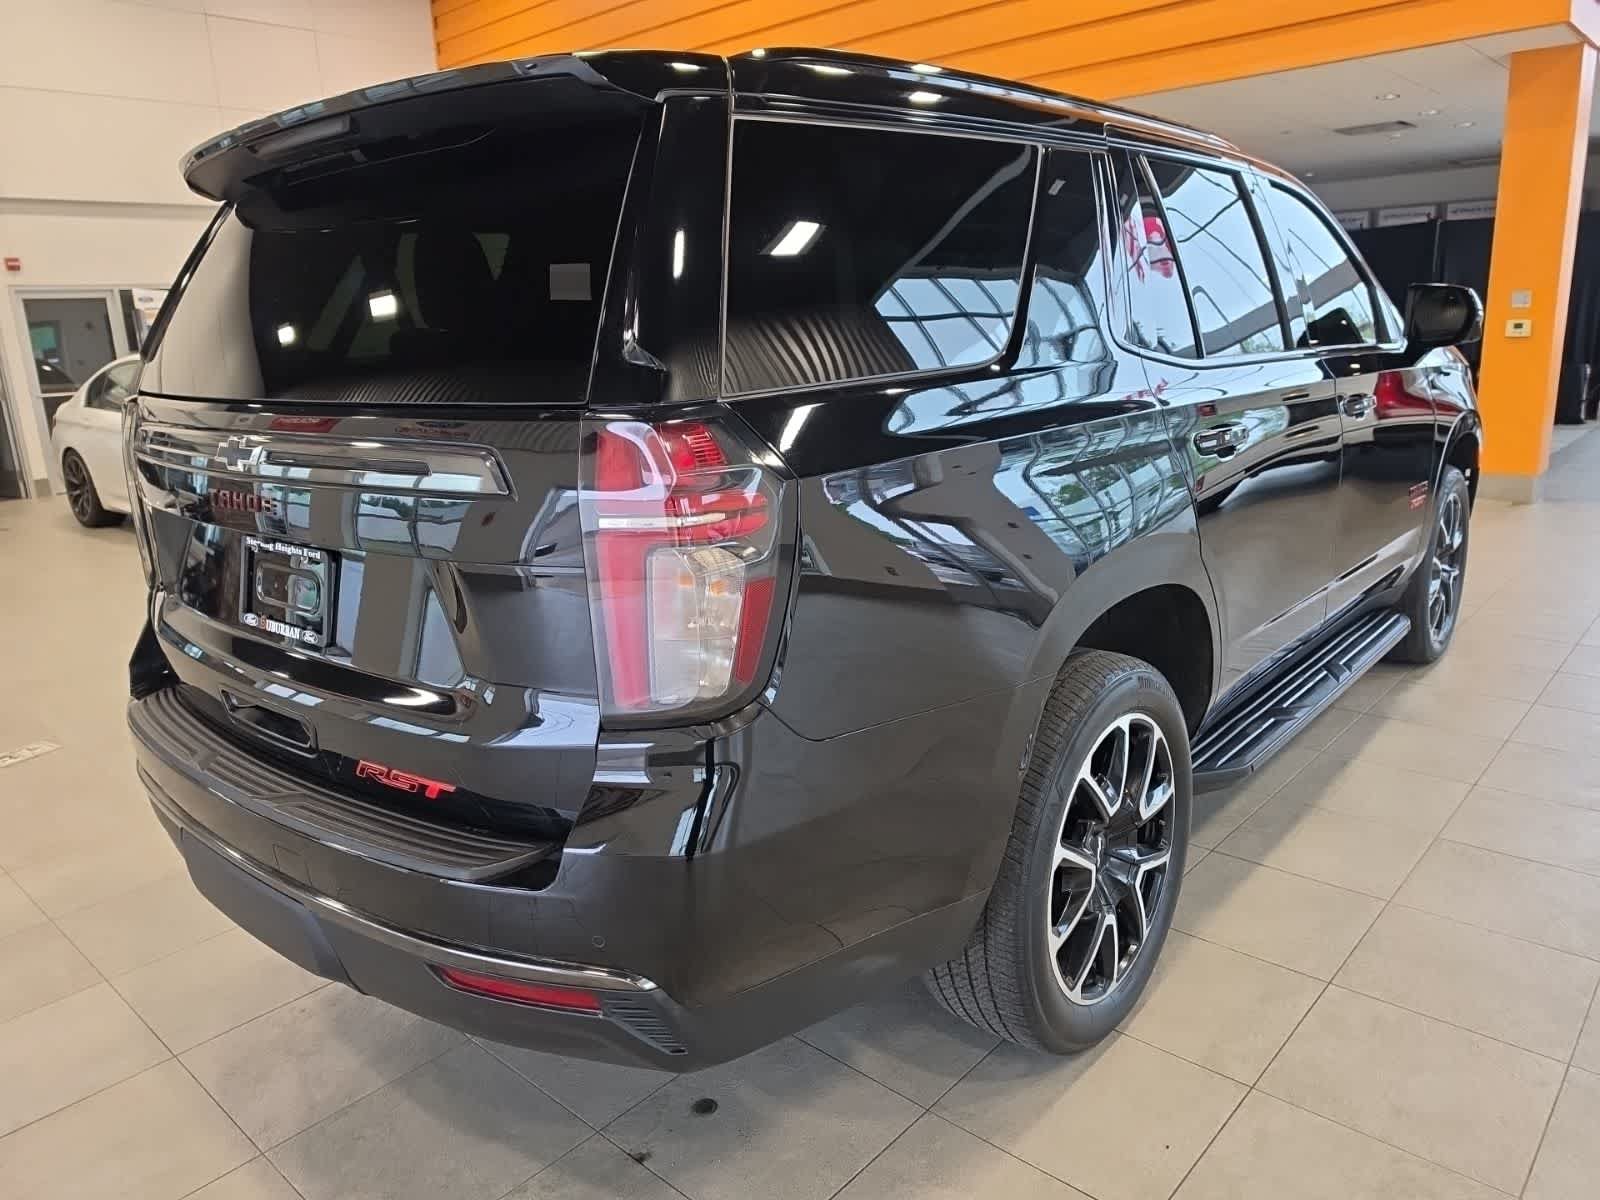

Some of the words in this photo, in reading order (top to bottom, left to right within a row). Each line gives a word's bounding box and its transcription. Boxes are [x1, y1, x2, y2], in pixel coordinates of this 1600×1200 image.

[208, 488, 277, 514] TAHOE
[275, 543, 303, 556] Heights
[303, 548, 321, 560] Ford
[356, 760, 456, 799] RST
